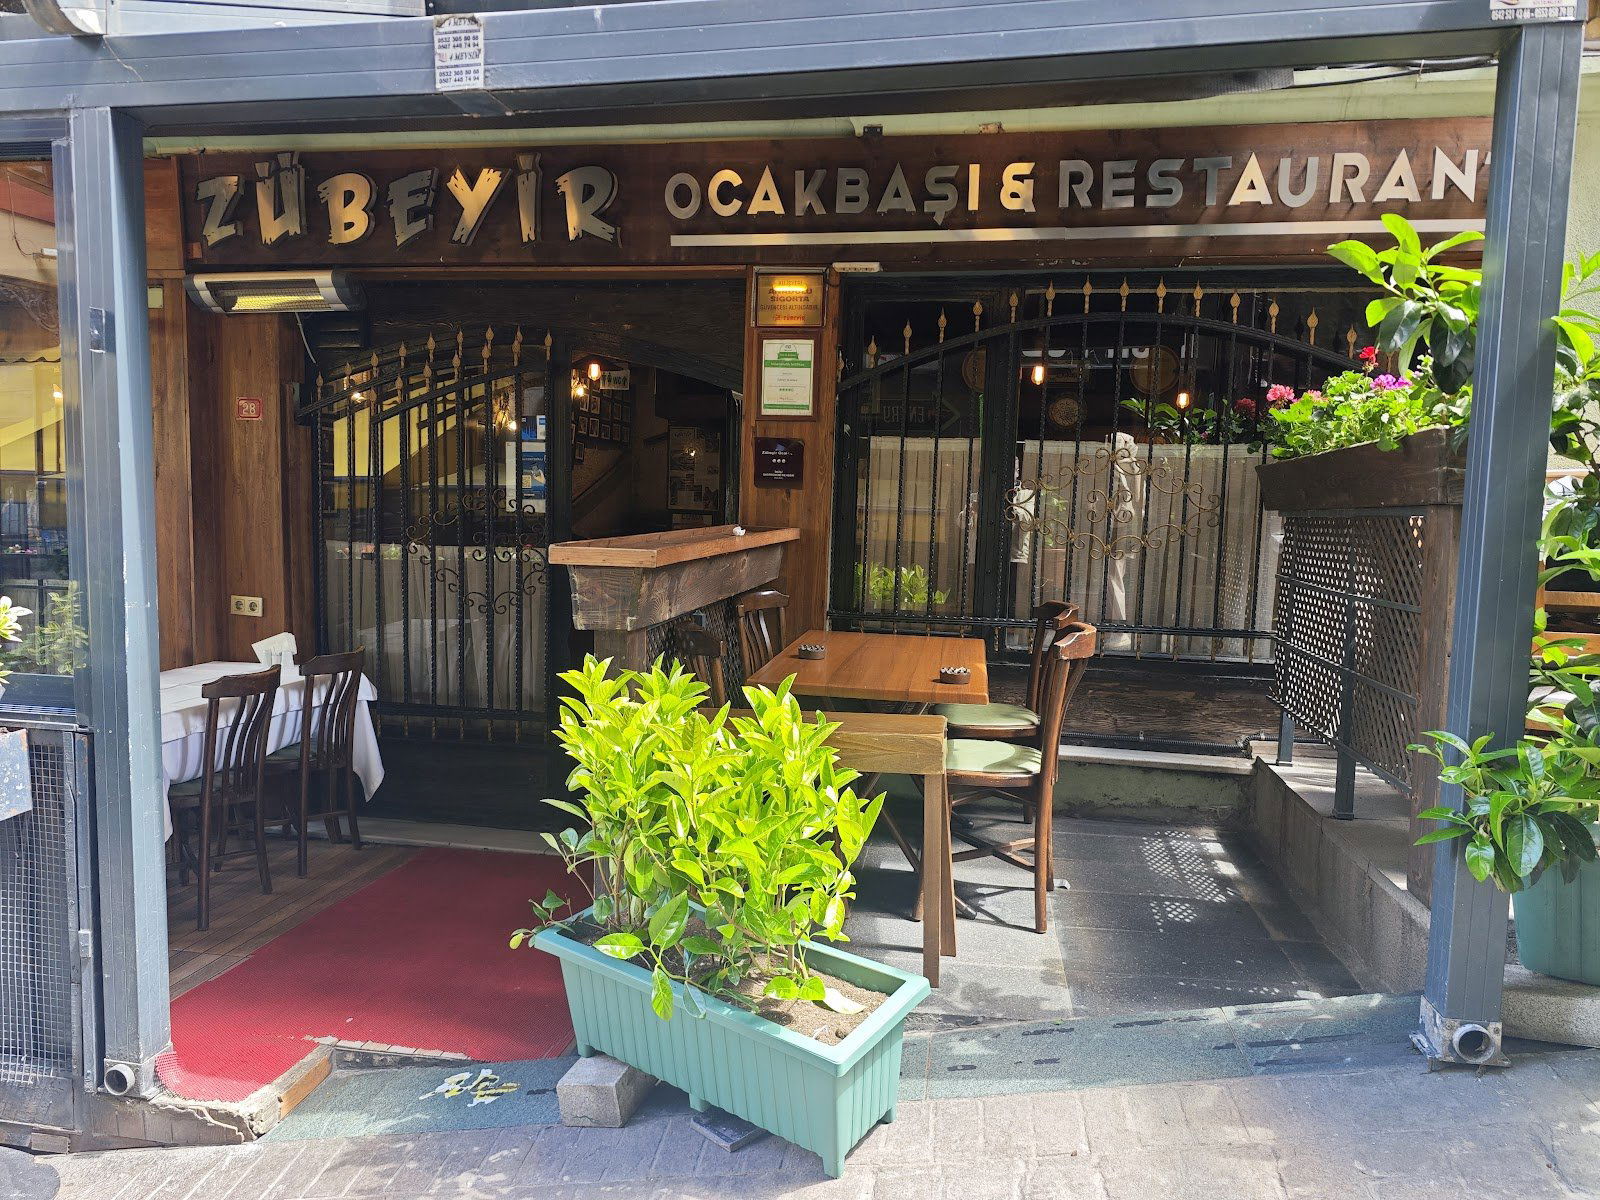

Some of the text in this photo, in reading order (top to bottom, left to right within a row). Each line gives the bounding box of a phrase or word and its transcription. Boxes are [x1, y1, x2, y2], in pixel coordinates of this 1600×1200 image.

[197, 152, 620, 248] ZÜBEYİR
[664, 145, 1491, 226] OCAKBAŞI & RESTAURAN
[242, 402, 256, 415] 28
